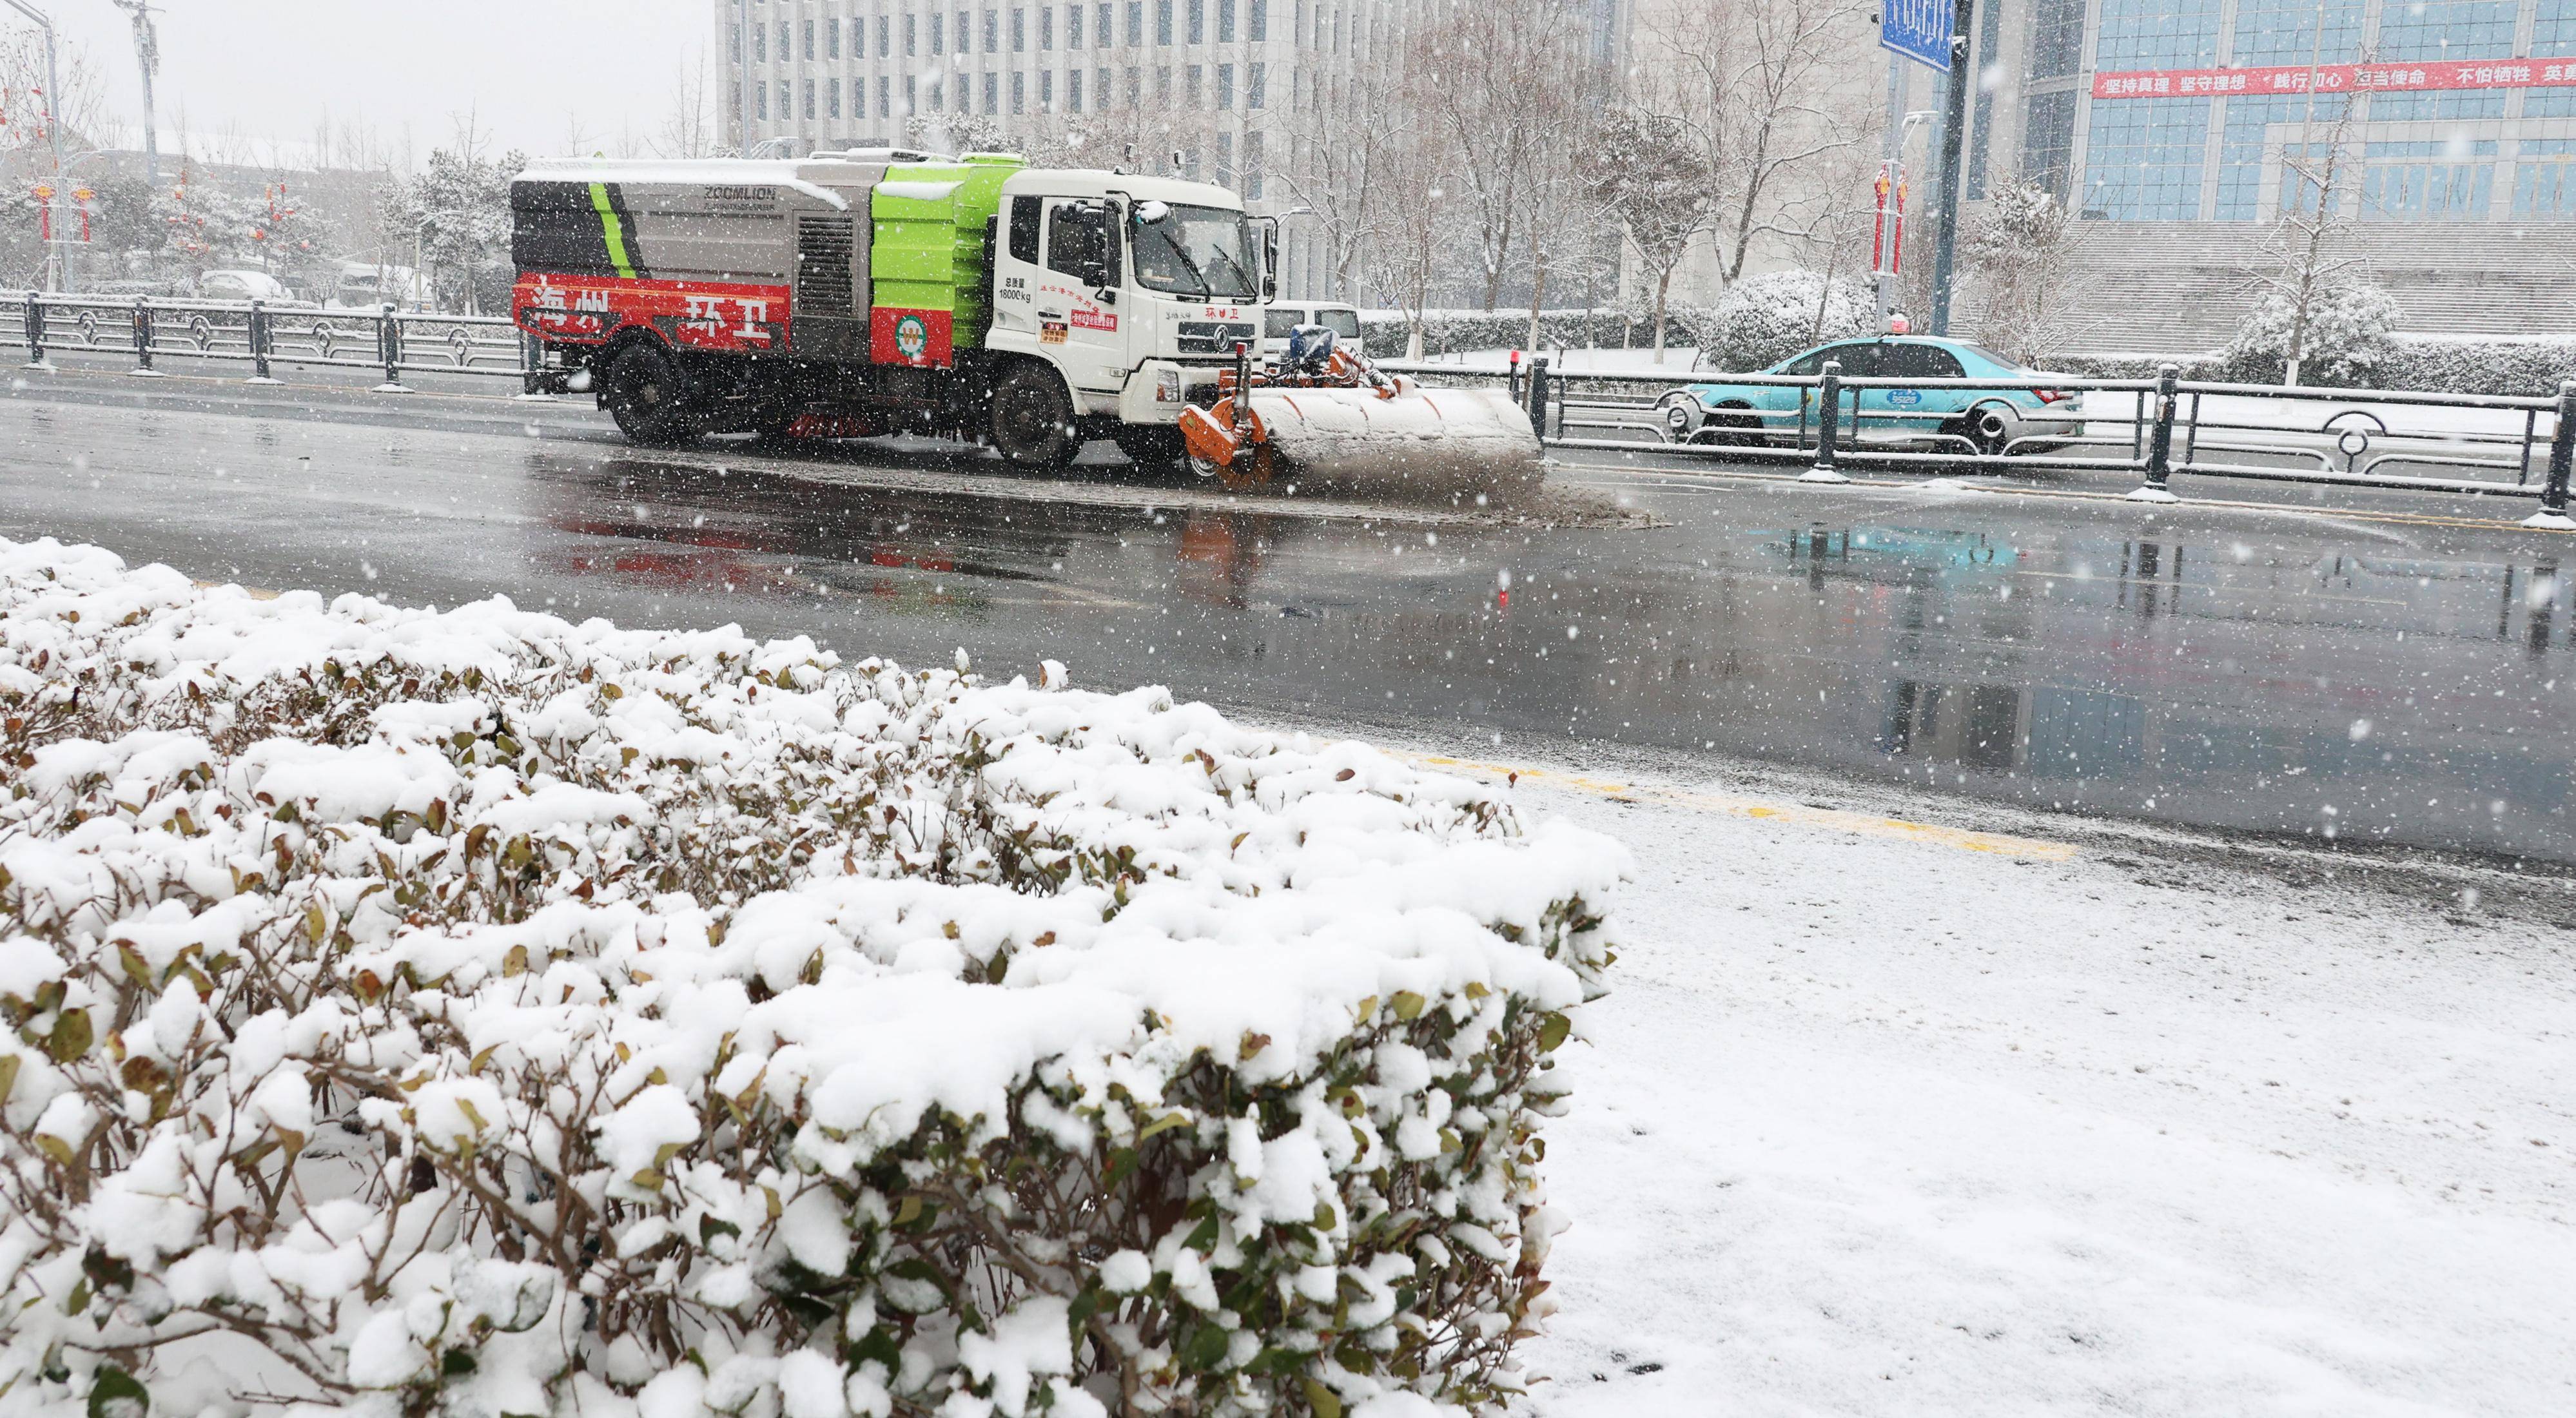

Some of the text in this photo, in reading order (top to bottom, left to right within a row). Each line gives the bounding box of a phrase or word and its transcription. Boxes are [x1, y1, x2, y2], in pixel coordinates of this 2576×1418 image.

[2105, 77, 2169, 93] 坚持真理
[2180, 75, 2246, 92] 坚守理想
[2456, 66, 2531, 84] 不怕牺牲
[704, 187, 776, 200] ZOOMLION
[1006, 277, 1024, 288] 总质量
[532, 287, 771, 340] 海州 环卫
